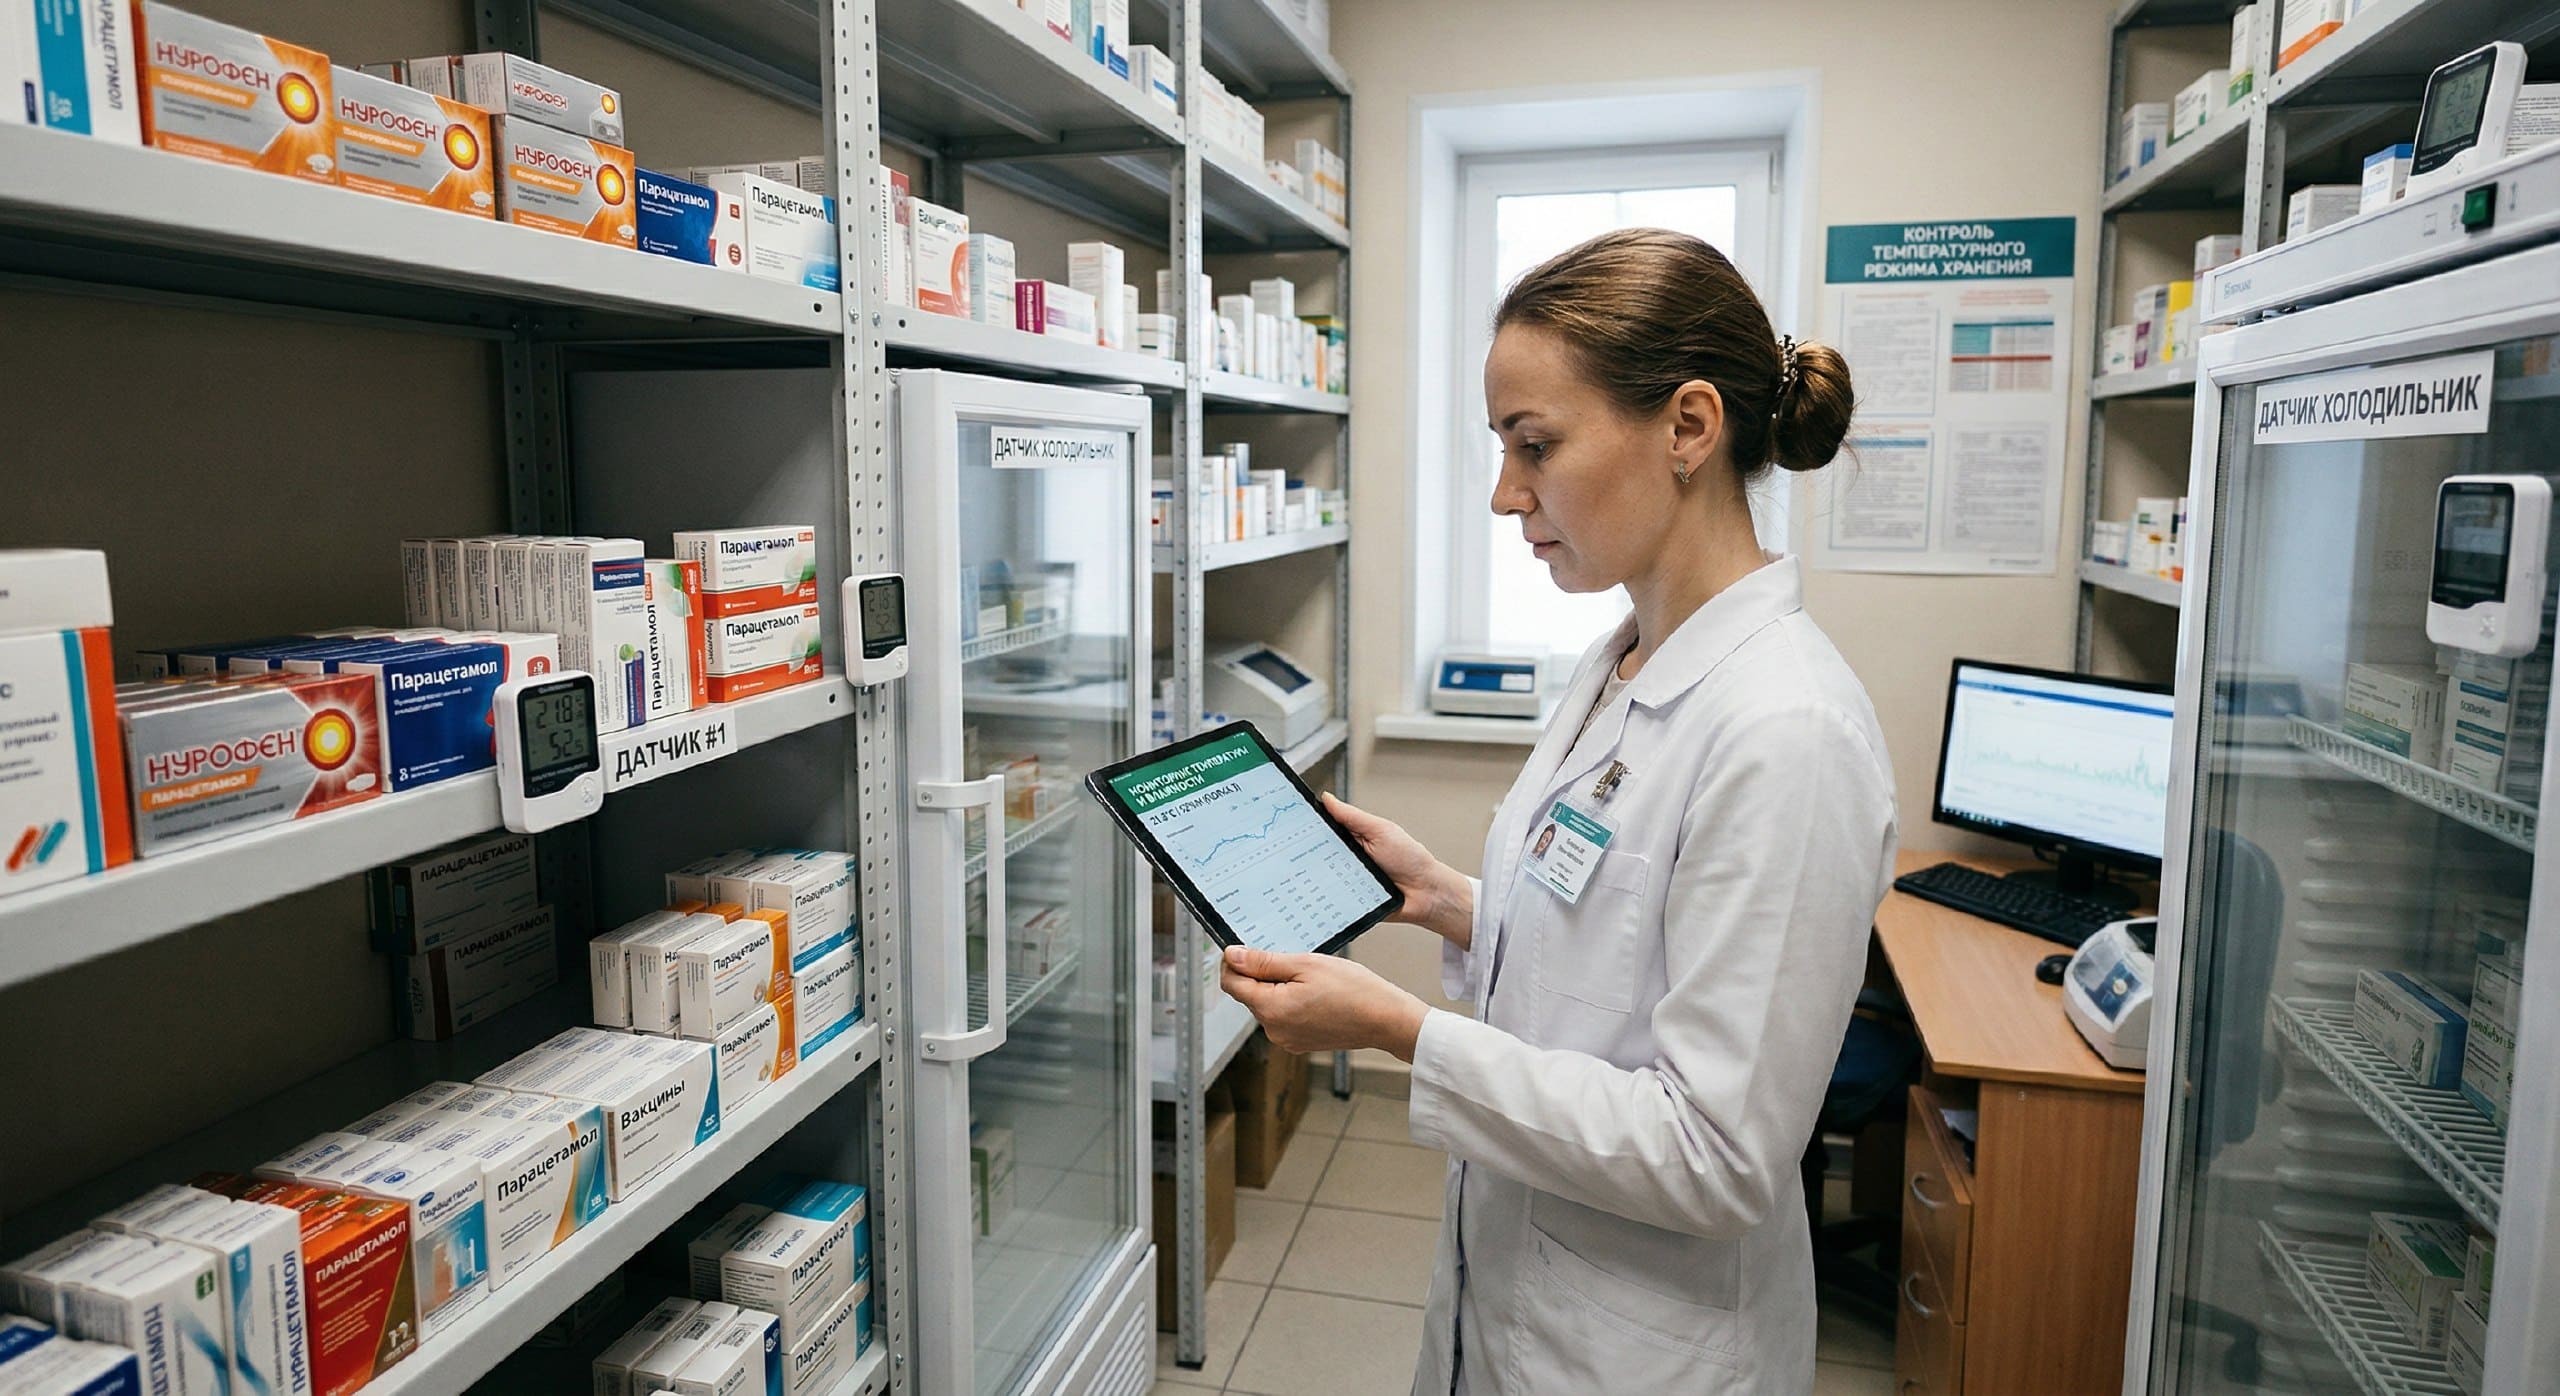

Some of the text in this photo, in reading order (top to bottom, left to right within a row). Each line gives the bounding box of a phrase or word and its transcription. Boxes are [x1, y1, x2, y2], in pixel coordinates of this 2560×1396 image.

[1872, 241, 2026, 261] ТЕМПЕРАТУРНОГО
[1903, 224, 1995, 243] КОНТРОЛЬ
[1863, 258, 2033, 279] РЕЖИМА ХРАНЕНИЯ
[2258, 373, 2483, 435] ДАТЧИК ХОЛОДИЛЬНИК
[994, 437, 1115, 463] ДАТЧИК ХОЛОДИЛЬНИК
[390, 660, 499, 693] Парацетамол
[646, 603, 663, 711] Парацетамол
[148, 730, 296, 784] НУРОФЕН
[615, 728, 702, 783] ДАТЧИК
[705, 722, 728, 751] #1
[621, 1079, 685, 1131] Вакцины
[497, 1127, 598, 1202] Парацетамол
[315, 1220, 407, 1284] ПАРАЦЕТАМОЛ
